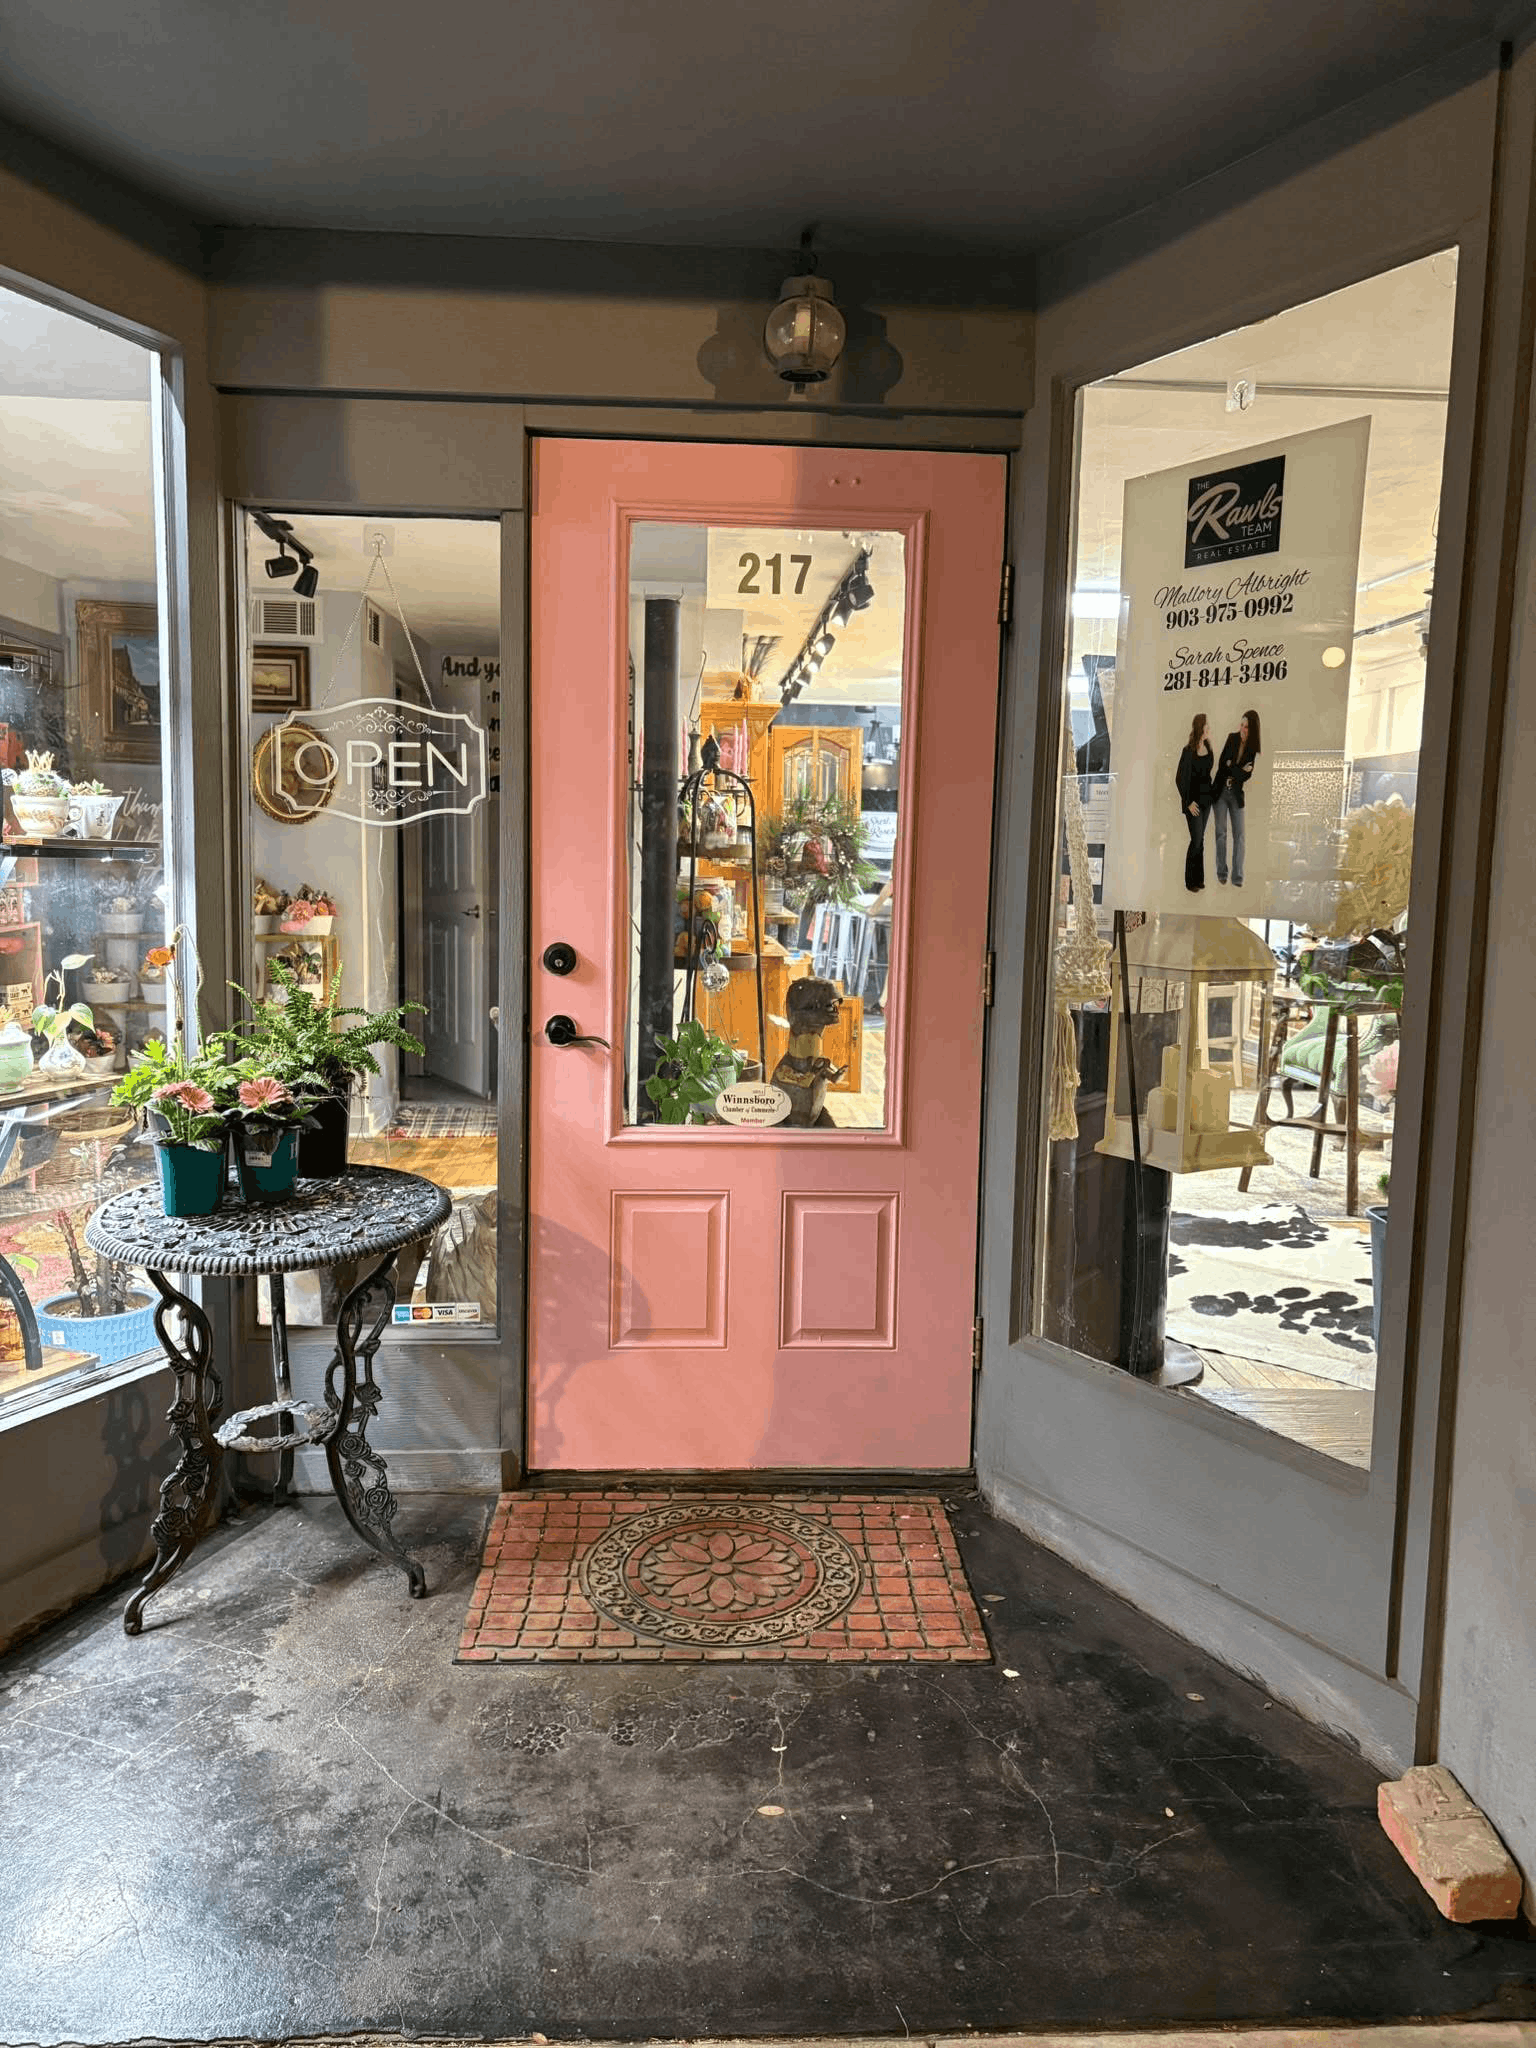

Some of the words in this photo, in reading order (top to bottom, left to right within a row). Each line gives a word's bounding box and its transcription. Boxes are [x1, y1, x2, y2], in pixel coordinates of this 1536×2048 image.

[1196, 481, 1210, 491] THE
[1187, 482, 1283, 544] Rawls
[1241, 521, 1272, 537] TEAM
[1196, 549, 1222, 560] REAL
[1228, 540, 1267, 555] ESTATE
[737, 552, 812, 595] 217
[1153, 585, 1224, 608] Mallory
[1225, 569, 1311, 600] Albright
[1166, 592, 1294, 630] 903-975-0992
[441, 655, 481, 677] And
[1168, 646, 1223, 669] Sarah
[1225, 639, 1285, 665] Spence
[1163, 660, 1288, 691] 281-844-3496
[293, 740, 468, 787] OPEN
[723, 1094, 775, 1105] Winnsboro
